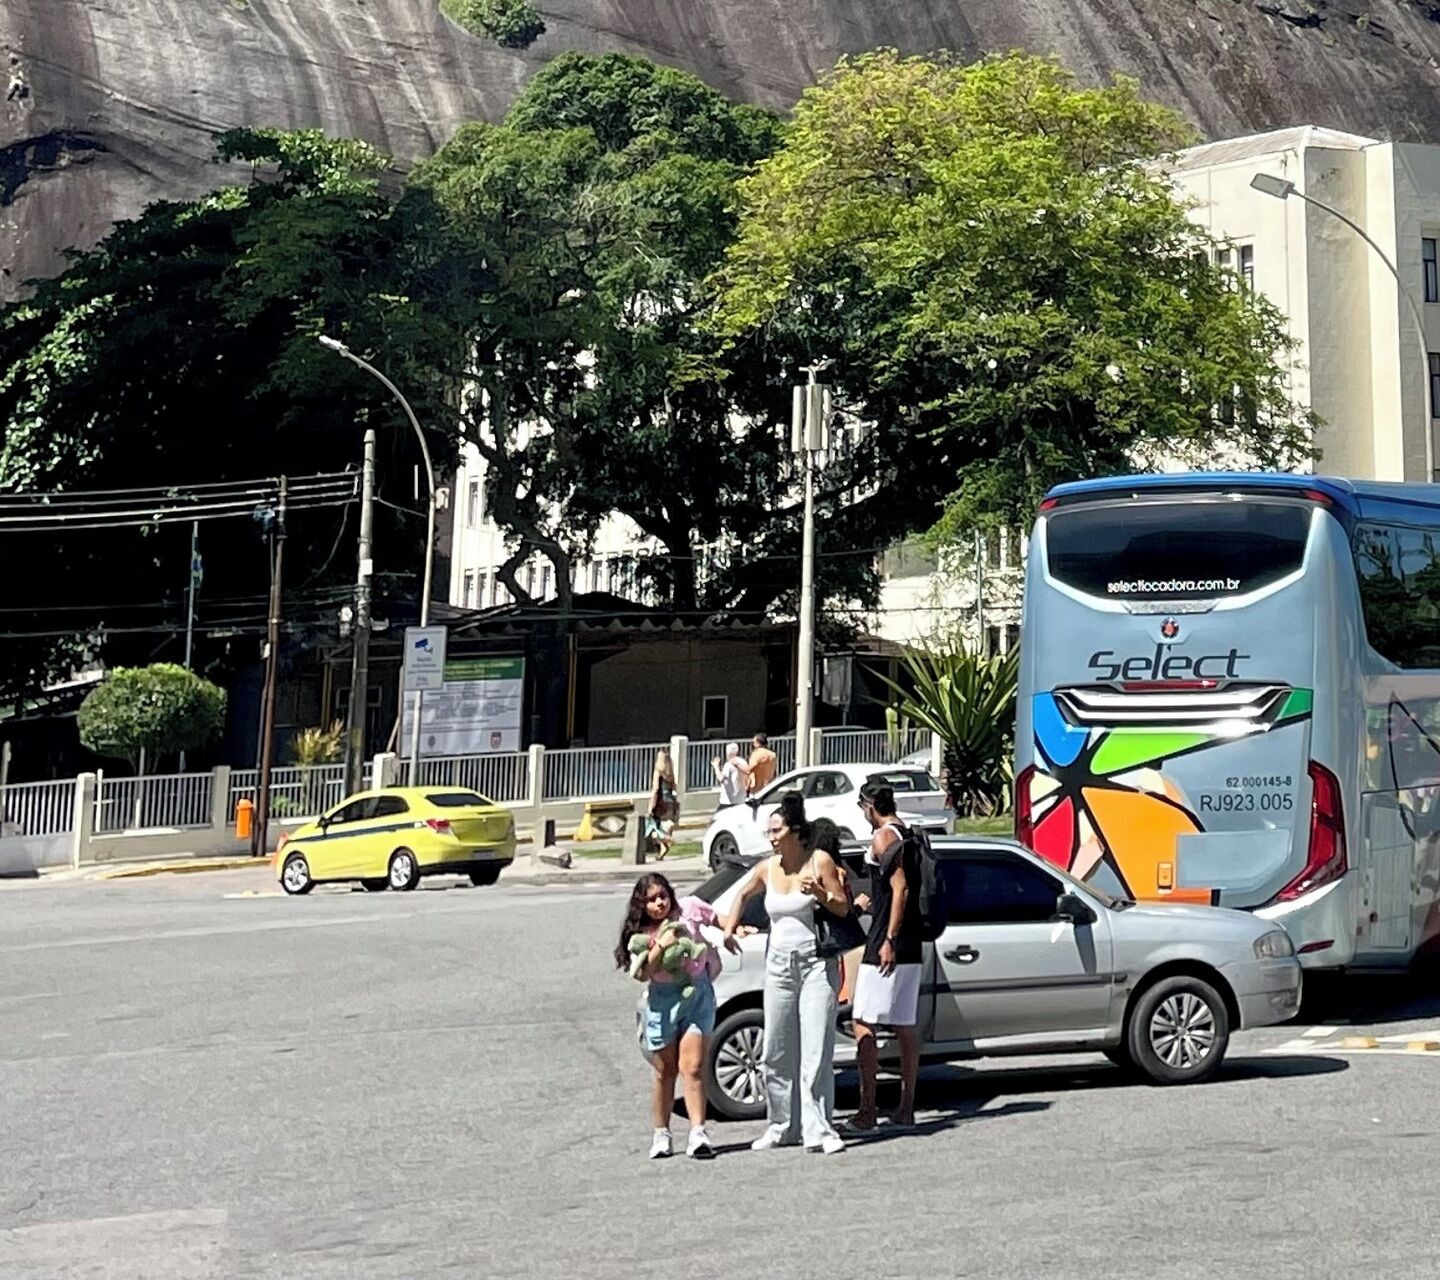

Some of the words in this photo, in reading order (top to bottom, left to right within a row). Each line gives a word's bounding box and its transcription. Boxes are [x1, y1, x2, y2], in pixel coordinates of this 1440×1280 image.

[1107, 577, 1241, 593] selectlocadora.com.br
[1088, 643, 1251, 681] Select
[1226, 776, 1293, 788] 62.000145-8
[1200, 794, 1293, 812] RJ923.005
